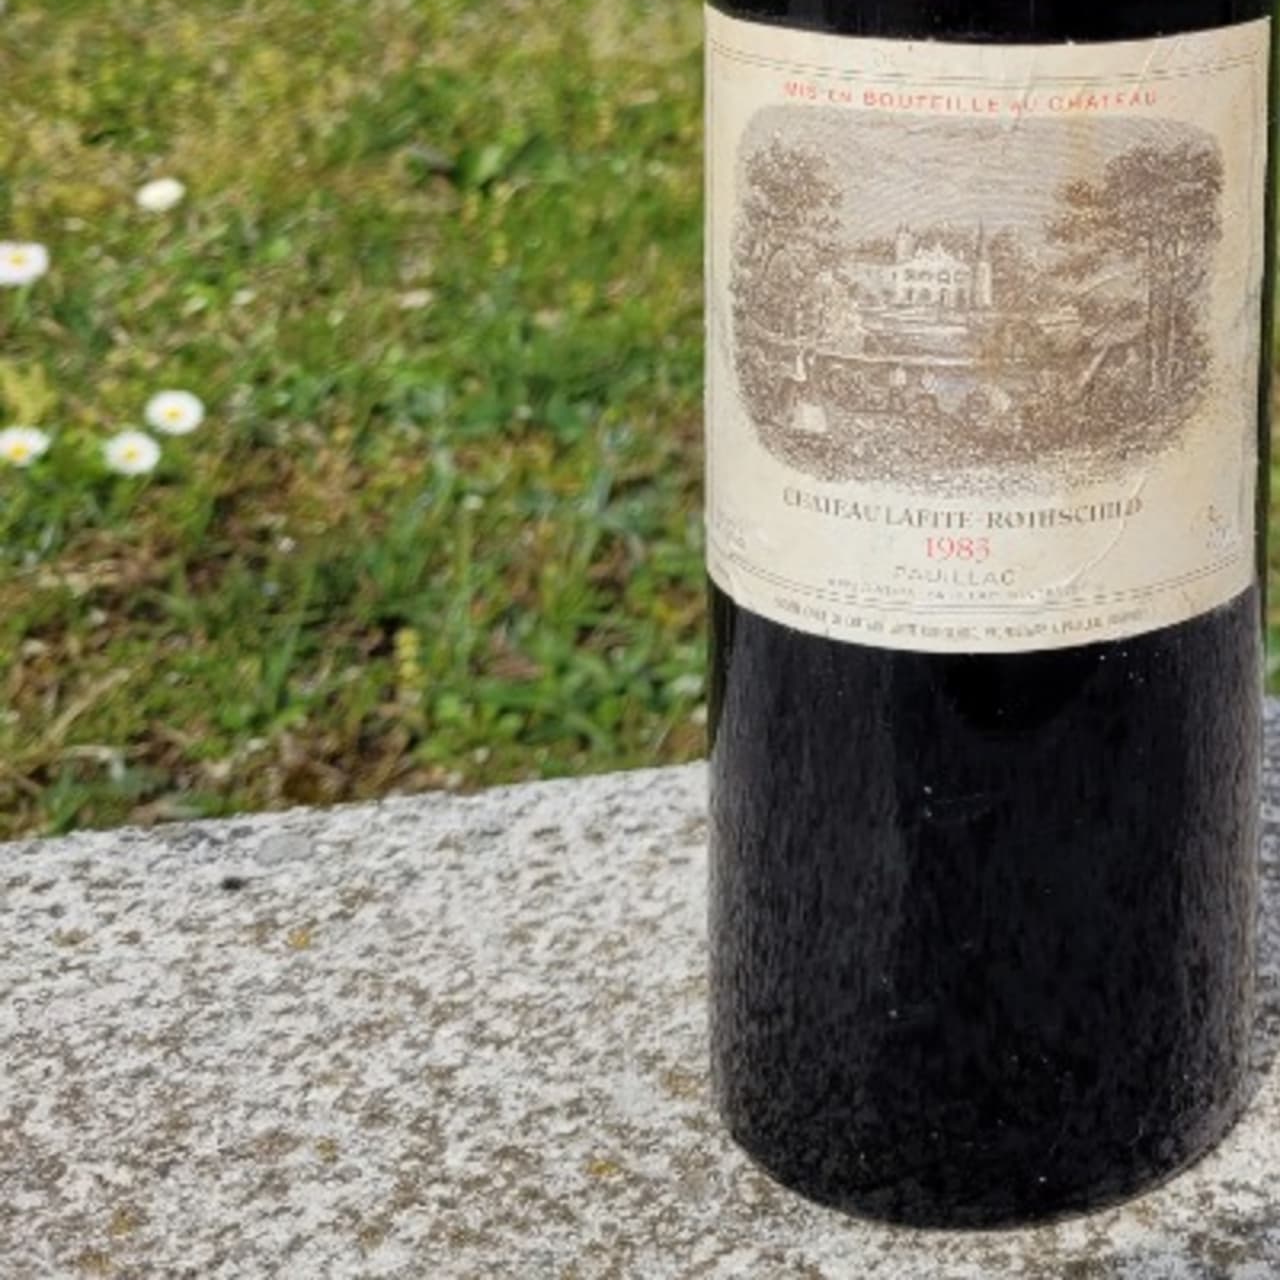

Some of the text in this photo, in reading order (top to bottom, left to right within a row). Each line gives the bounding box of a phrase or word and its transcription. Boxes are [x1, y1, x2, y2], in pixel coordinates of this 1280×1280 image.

[783, 81, 817, 100] MIS
[863, 90, 999, 113] BOUTEILLE
[885, 505, 974, 529] LAFITE
[986, 496, 1144, 529] ROTHSCHILD
[893, 565, 1017, 587] PAUILLAC
